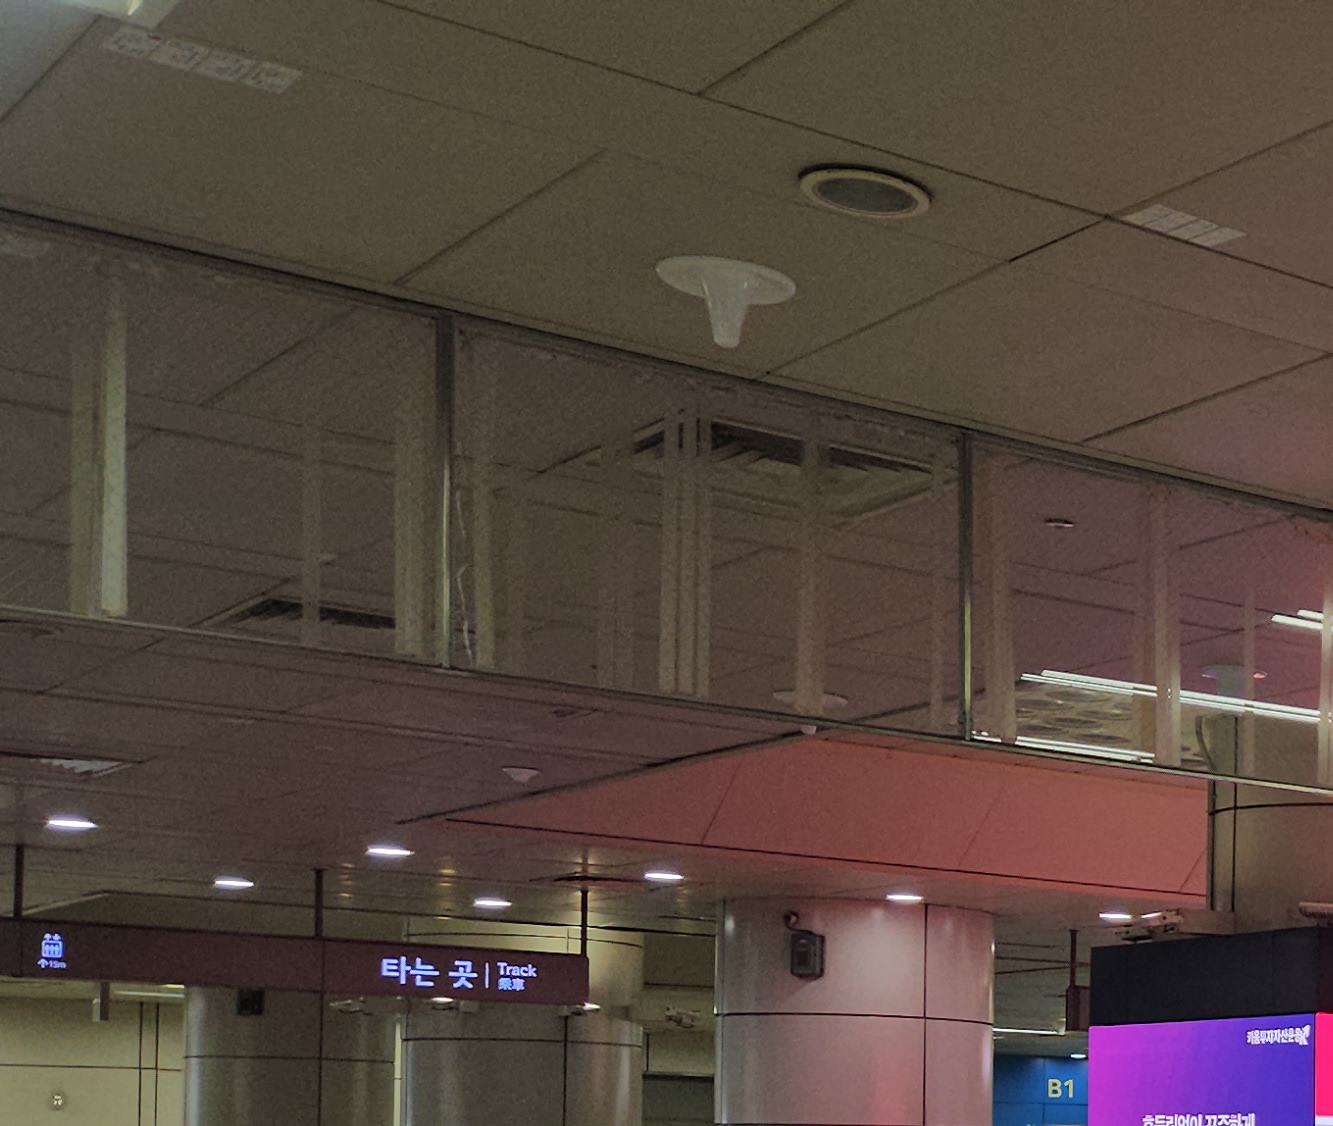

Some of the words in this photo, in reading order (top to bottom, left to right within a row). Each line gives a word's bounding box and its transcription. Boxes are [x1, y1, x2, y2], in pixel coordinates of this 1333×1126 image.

[378, 956, 440, 987] 타는
[448, 959, 479, 989] 곳
[497, 962, 538, 978] Track
[1047, 1078, 1074, 1099] B1
